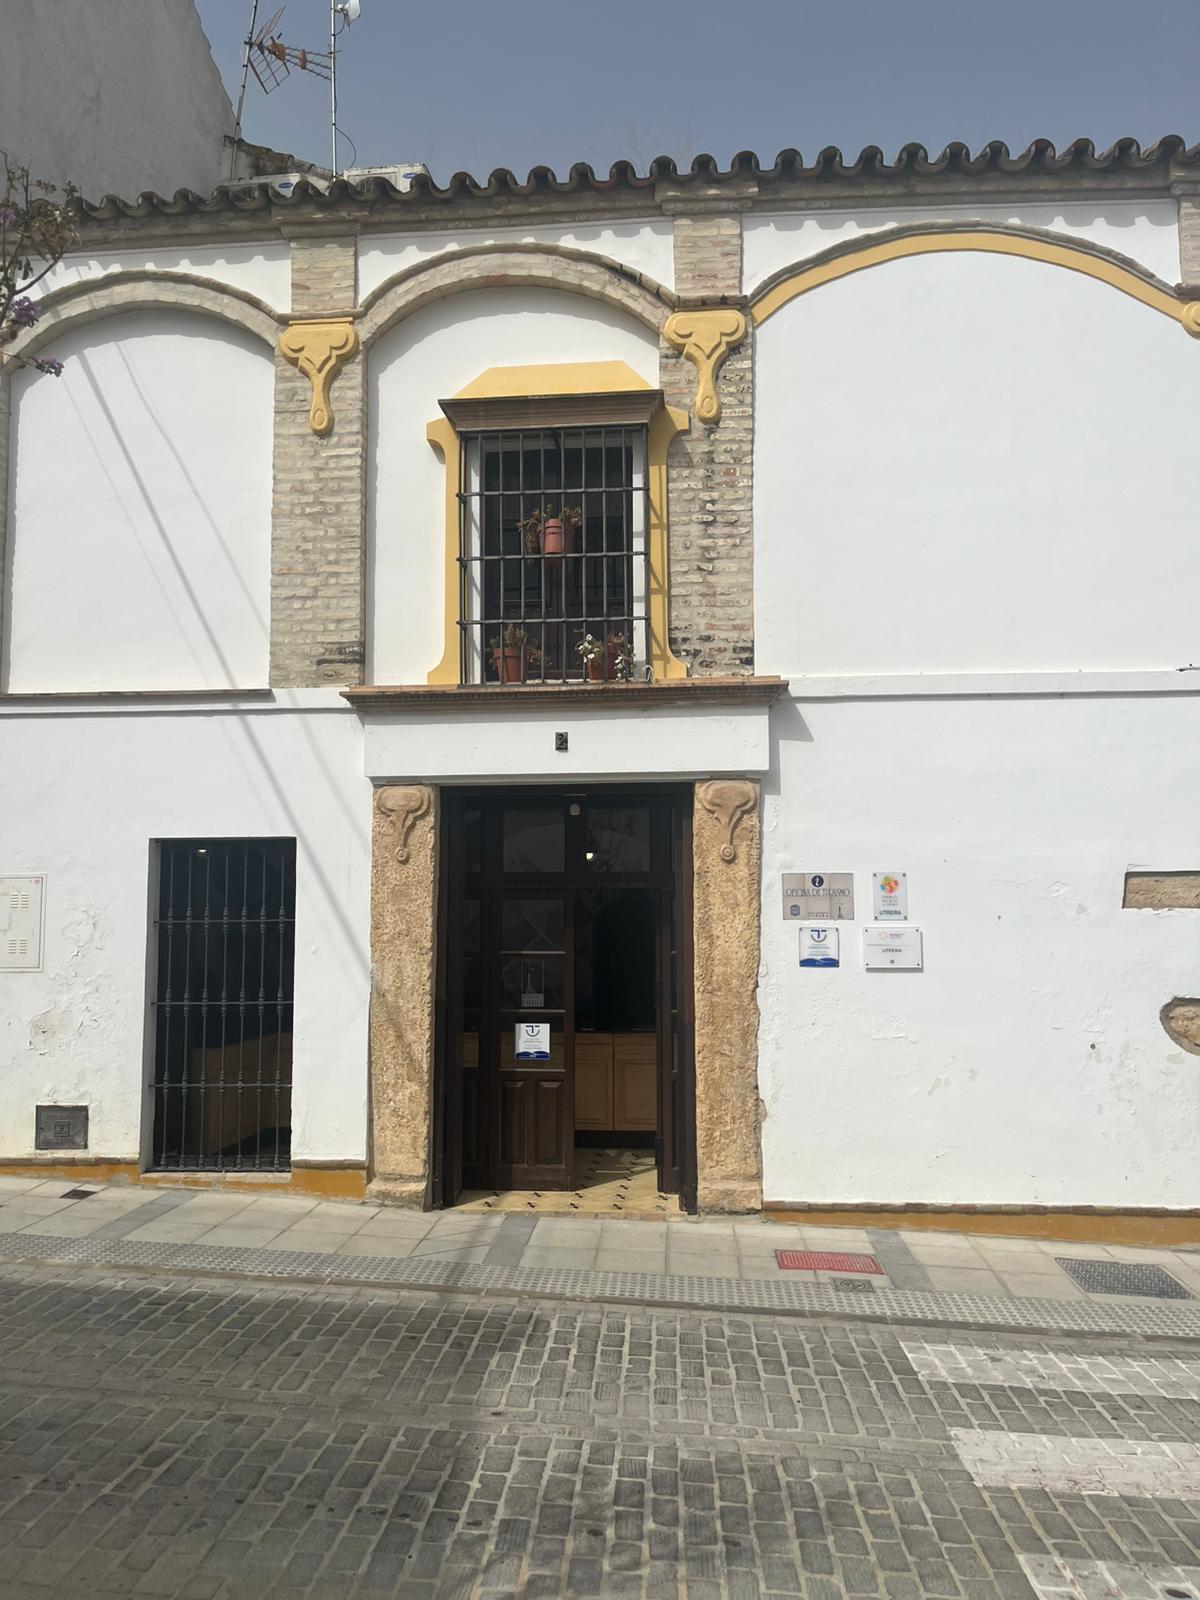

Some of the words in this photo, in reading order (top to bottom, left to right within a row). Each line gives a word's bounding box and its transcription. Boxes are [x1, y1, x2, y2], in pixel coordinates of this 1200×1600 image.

[786, 888, 811, 897] OFICINA
[811, 888, 821, 897] DE
[822, 888, 851, 897] TURISMO
